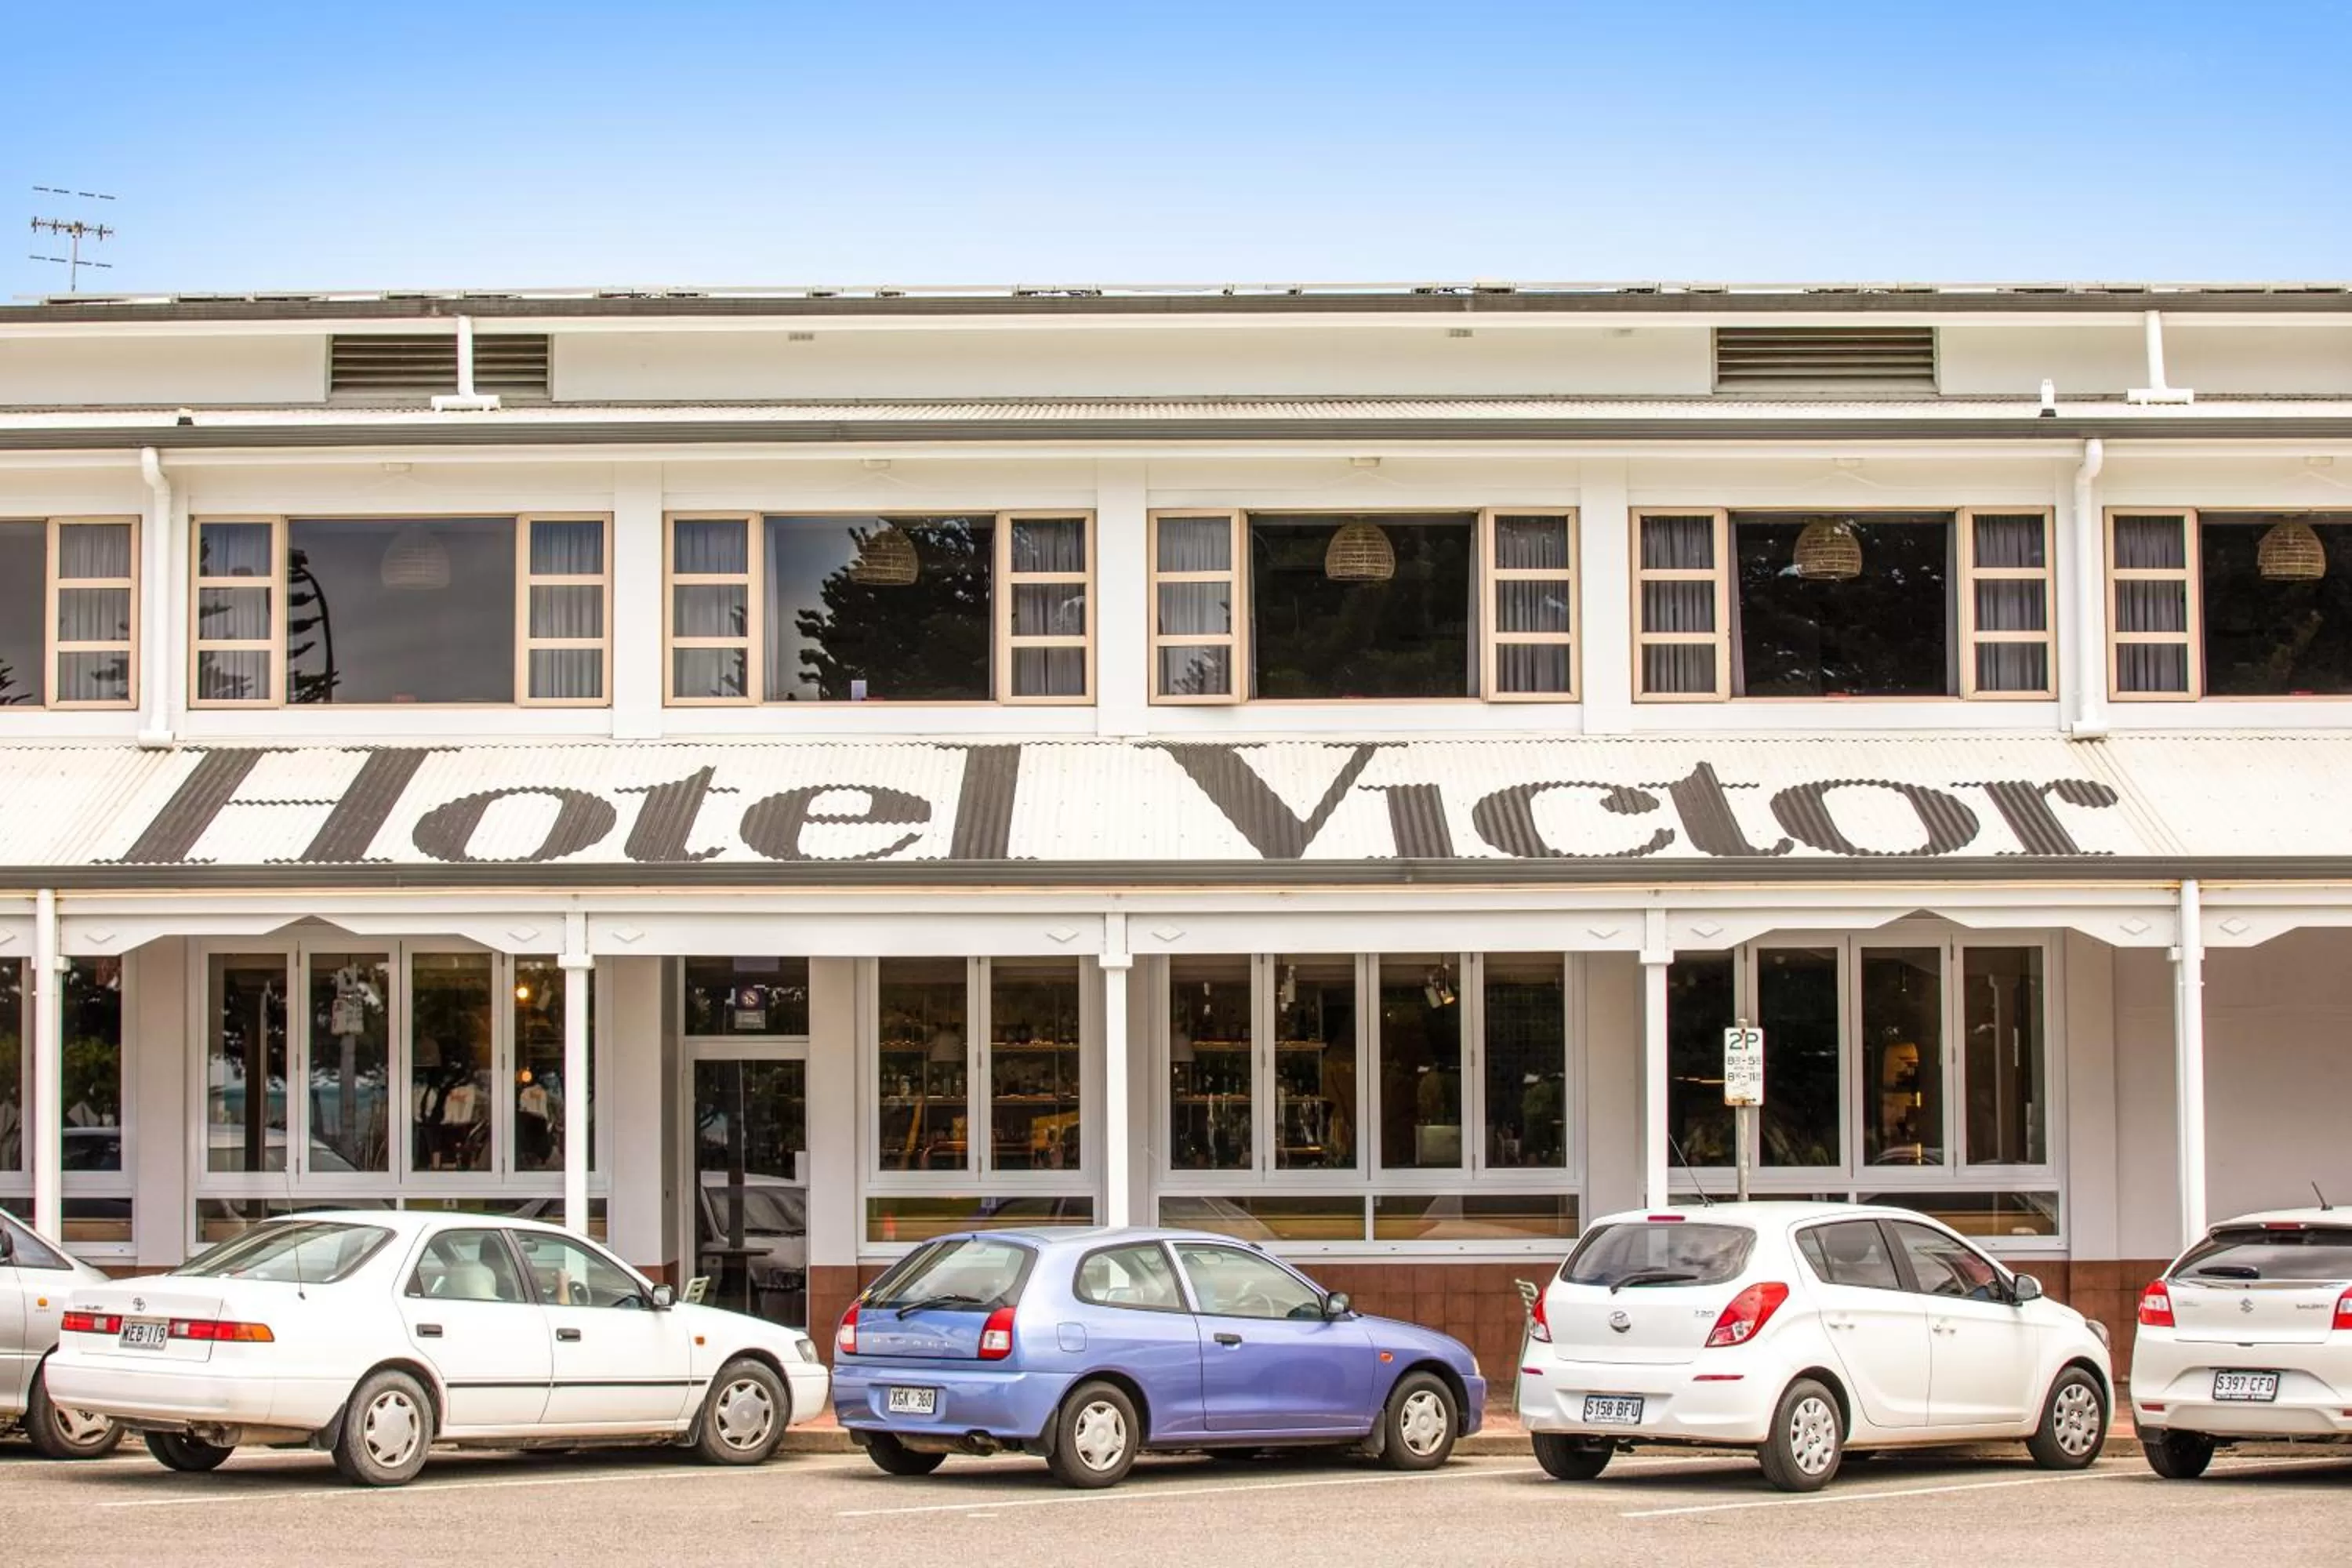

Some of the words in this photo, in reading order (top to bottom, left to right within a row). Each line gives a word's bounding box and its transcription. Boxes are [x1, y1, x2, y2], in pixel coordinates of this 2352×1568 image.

[90, 742, 1038, 864] Hotel
[1134, 739, 2118, 861] Victor
[1729, 1033, 1759, 1050] 2P
